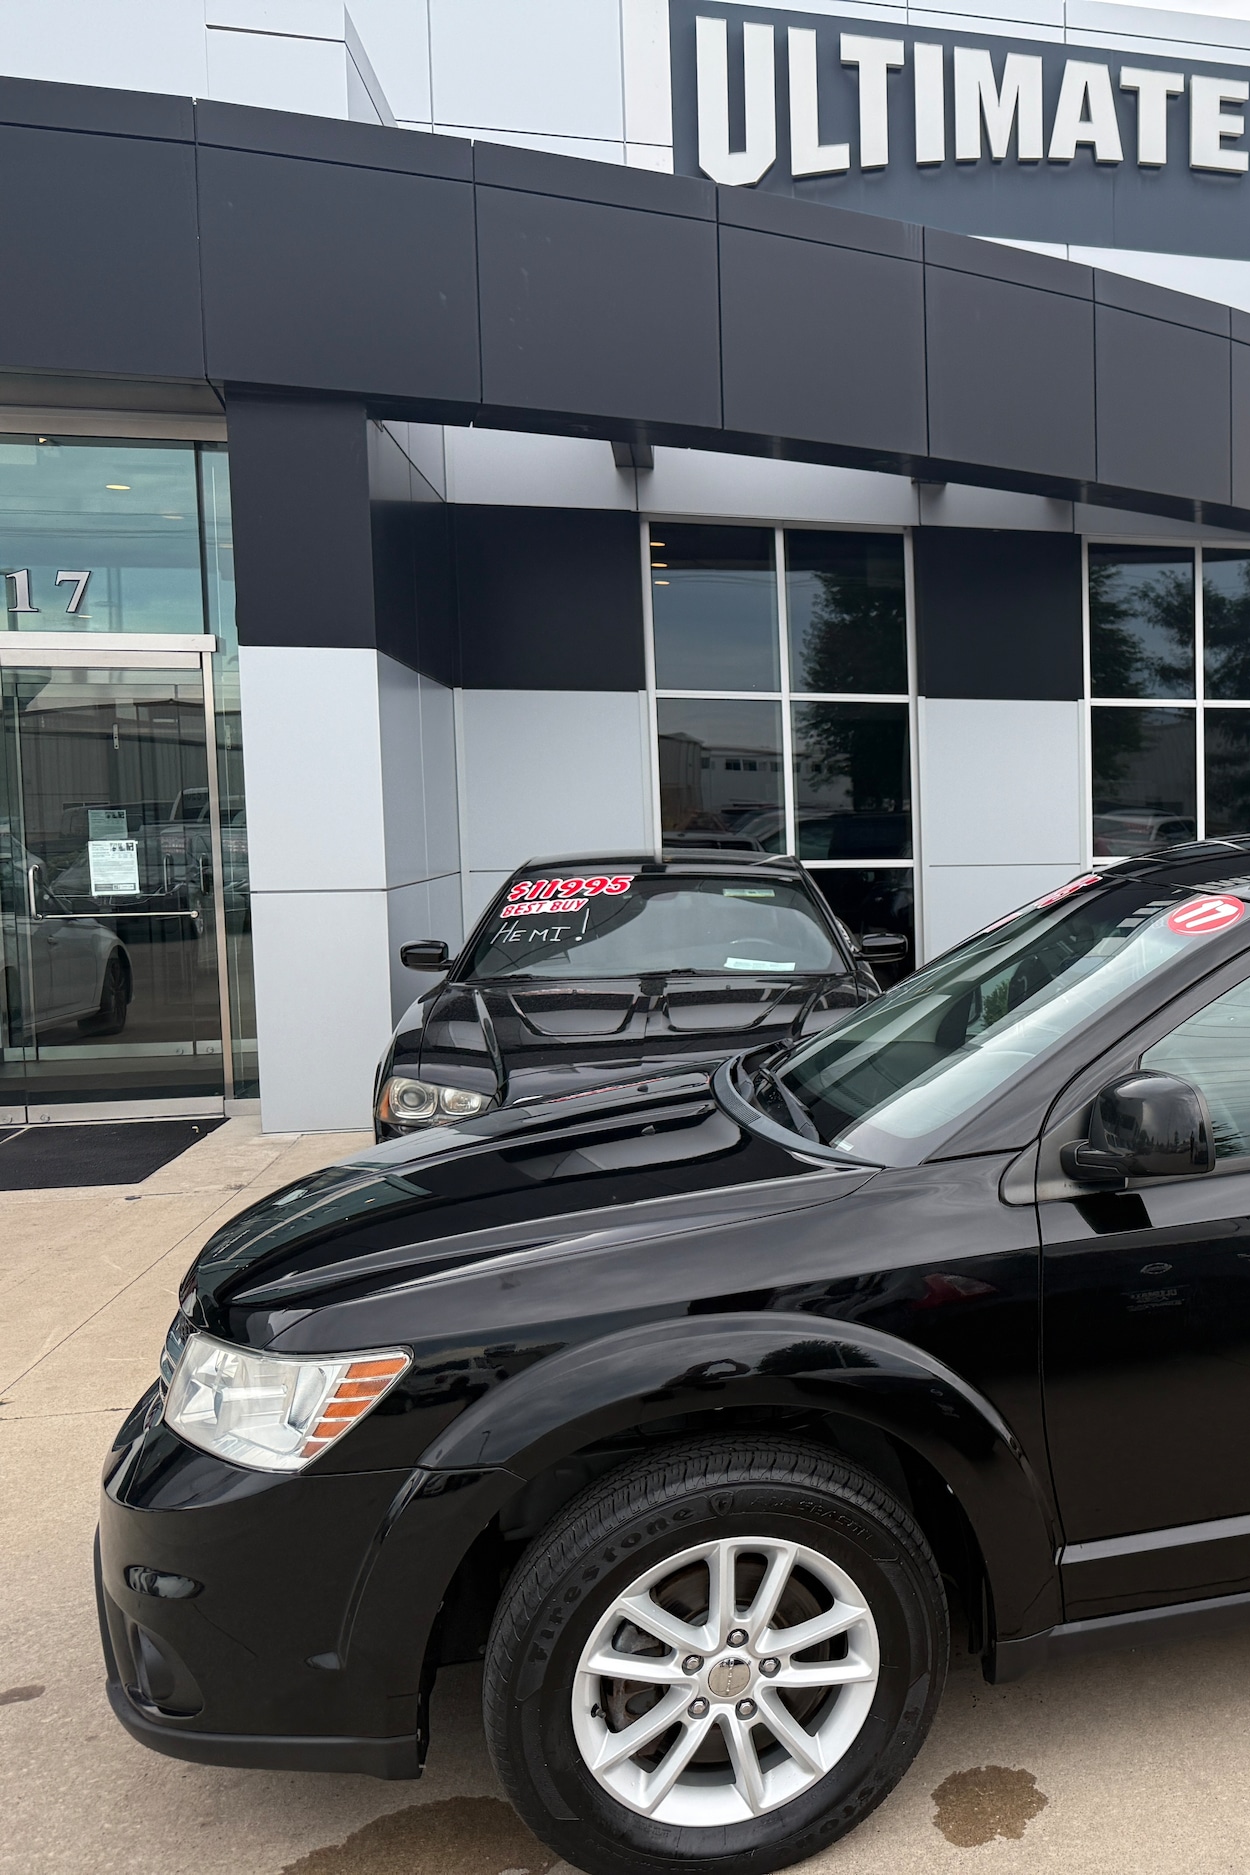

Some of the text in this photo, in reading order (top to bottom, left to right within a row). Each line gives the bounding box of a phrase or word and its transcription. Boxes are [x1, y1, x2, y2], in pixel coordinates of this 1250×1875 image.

[695, 16, 1250, 188] ULTIMATE
[508, 876, 635, 901] $11995
[501, 898, 589, 918] BEST BUY
